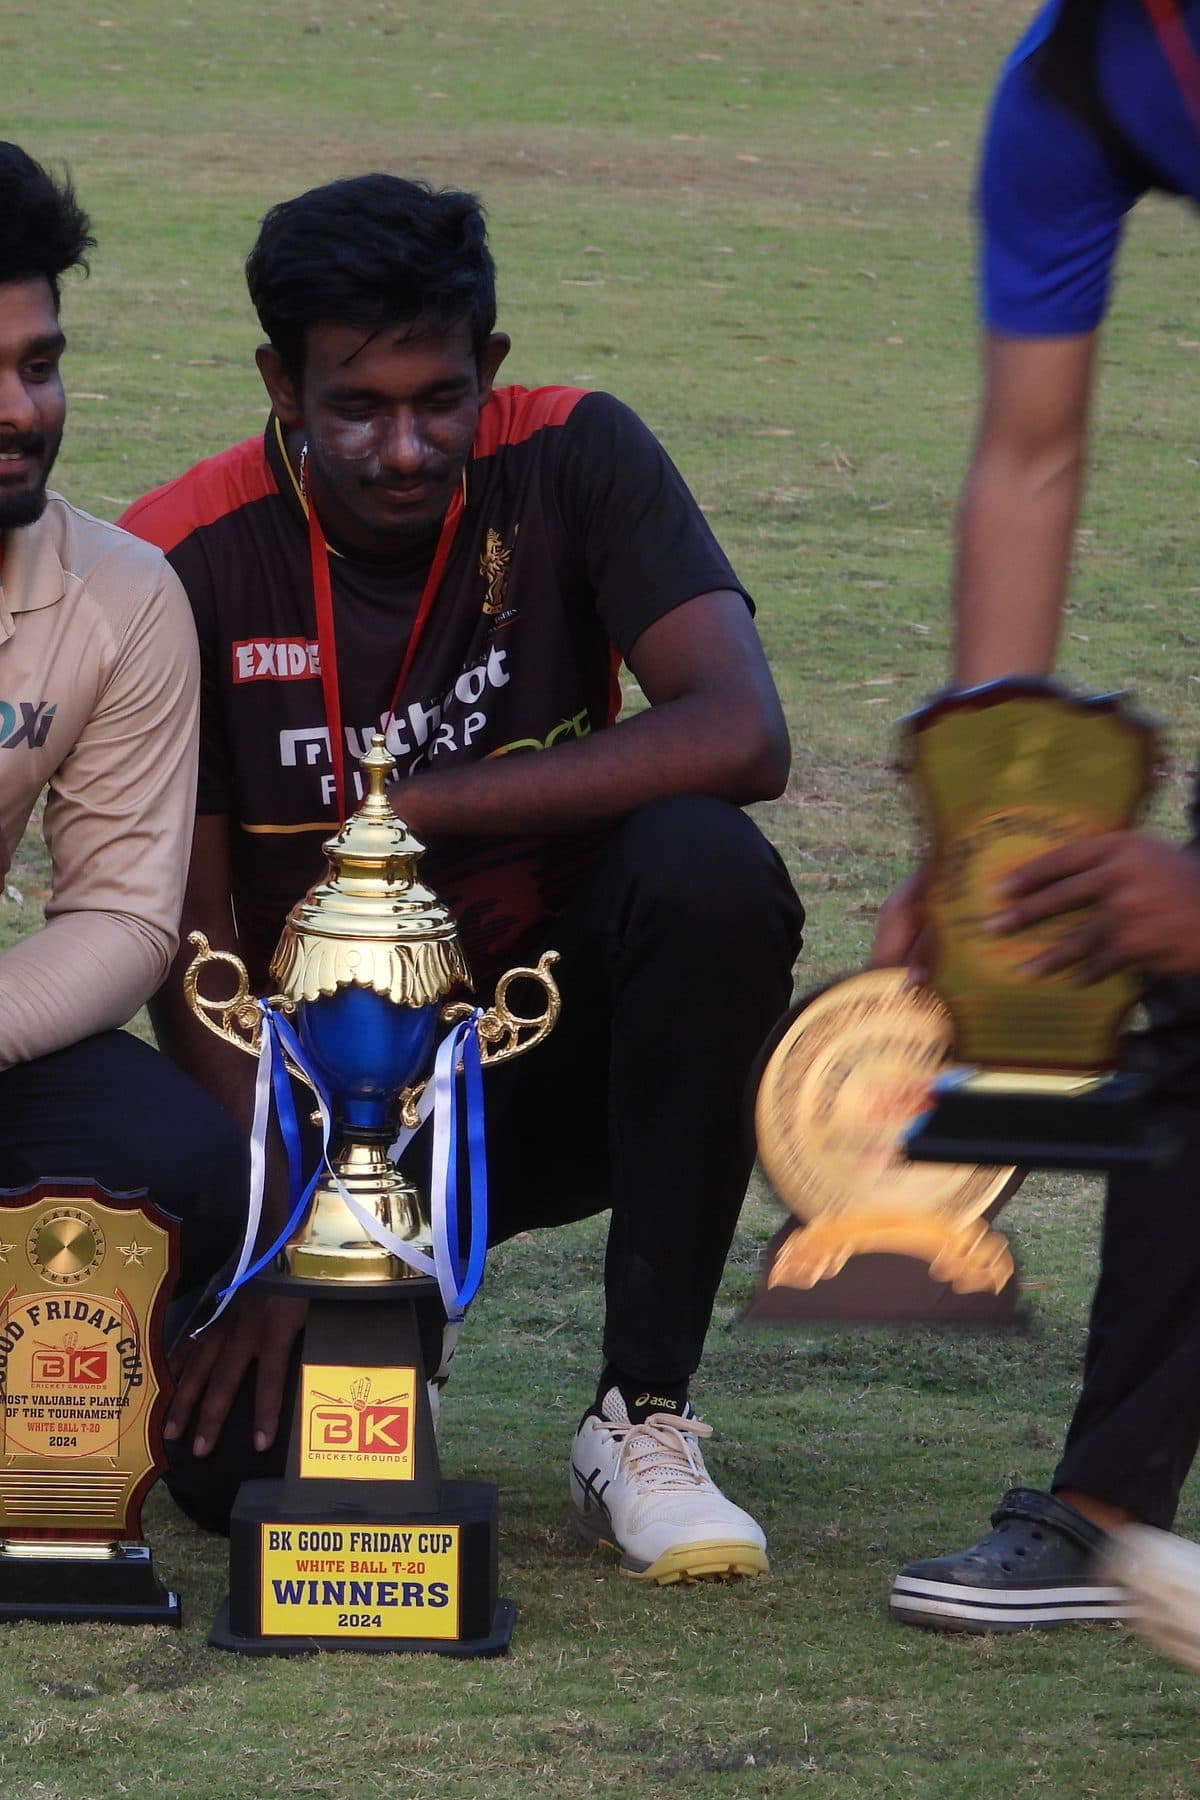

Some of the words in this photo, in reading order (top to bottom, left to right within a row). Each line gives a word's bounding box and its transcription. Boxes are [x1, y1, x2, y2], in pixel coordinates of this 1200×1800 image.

[236, 643, 322, 679] EXIDE
[26, 1300, 122, 1336] FRIDAY
[115, 1337, 143, 1387] CUP
[36, 1355, 101, 1380] BK
[32, 1395, 86, 1406] VALUABLE
[89, 1396, 130, 1407] PLAYER
[650, 1396, 678, 1409] asics
[6, 1408, 19, 1418] OF
[22, 1408, 45, 1418] THE
[48, 1409, 122, 1420] TOURNAMENT
[27, 1422, 55, 1432] WHITE
[58, 1423, 79, 1433] BALL
[81, 1423, 100, 1433] T-20
[316, 1412, 401, 1447] BK
[49, 1436, 77, 1447] 2024
[308, 1452, 354, 1461] CRICKET
[356, 1454, 408, 1463] GROUNDS
[269, 1531, 292, 1551] BK
[298, 1531, 343, 1552] GOOD
[350, 1532, 412, 1553] FRIDAY
[418, 1533, 453, 1554] CUP
[296, 1560, 345, 1573] WHITE
[350, 1561, 387, 1574] BALL
[392, 1561, 426, 1575] T-20
[272, 1579, 449, 1608] WINNERS
[338, 1614, 382, 1628] 2024
